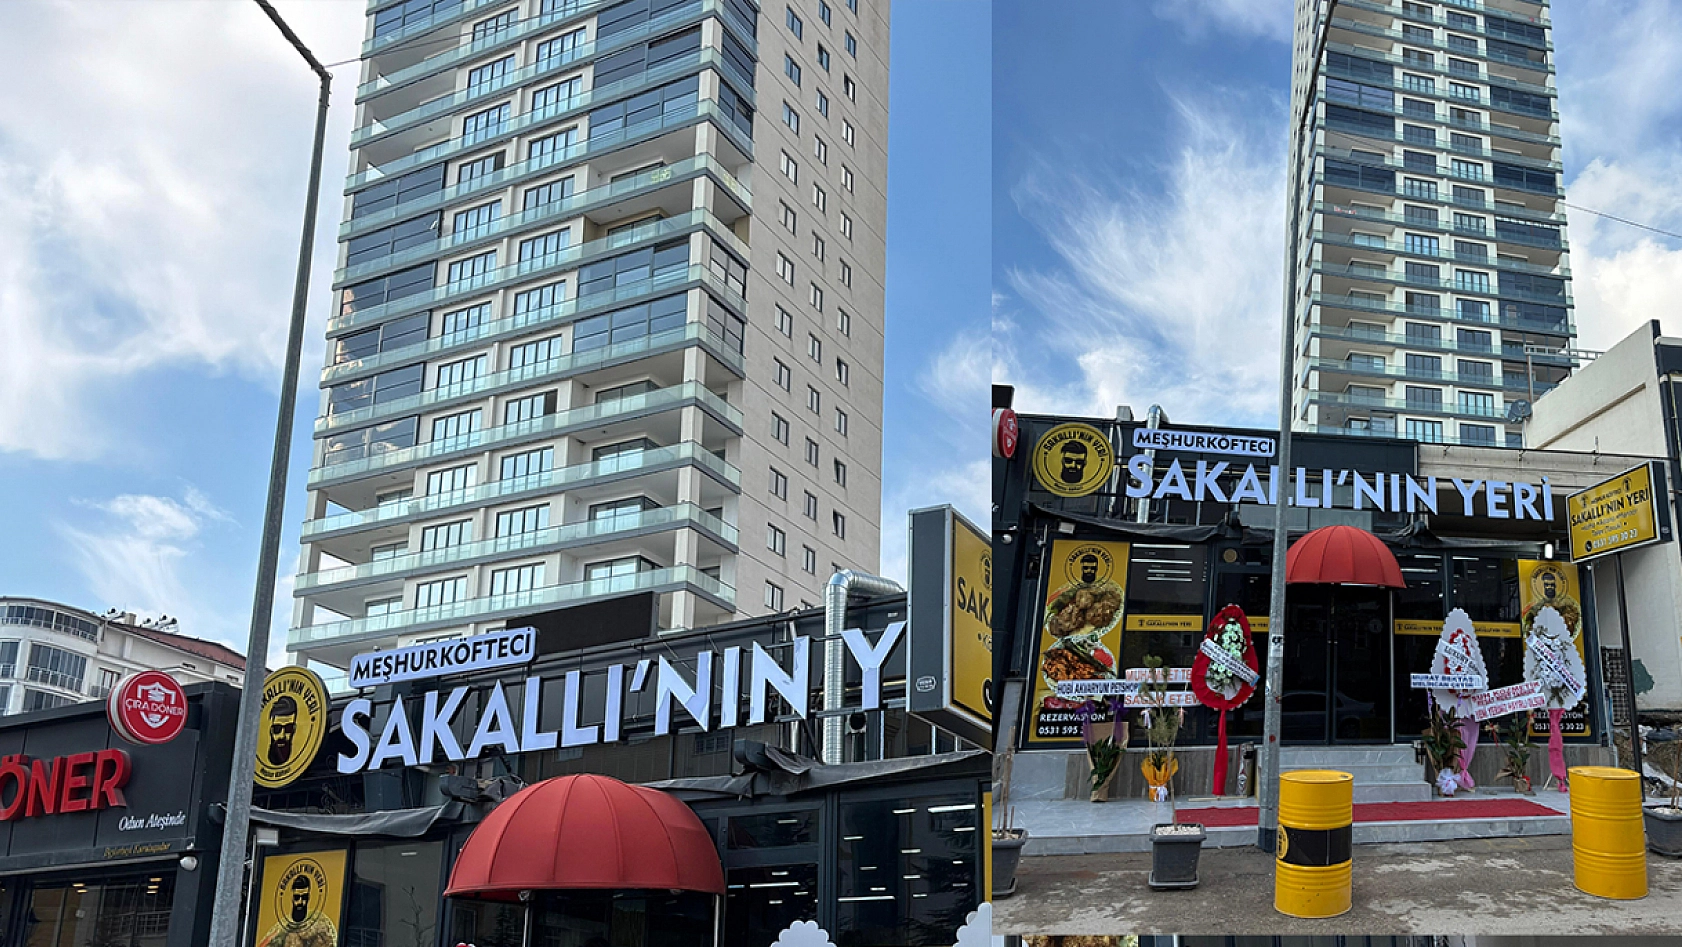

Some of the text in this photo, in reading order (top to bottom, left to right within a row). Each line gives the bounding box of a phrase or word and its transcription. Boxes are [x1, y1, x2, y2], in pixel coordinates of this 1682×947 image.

[1137, 430, 1273, 454] MEŞHURKÖFTECİ
[1126, 453, 1555, 522] SAKALLI'NIN YERİ
[1626, 484, 1650, 508] YERİ
[353, 626, 533, 683] MEŞHURKÖFTECİ
[336, 634, 811, 774] SAKALLI'NIN
[1038, 725, 1059, 735] 0531
[1061, 725, 1078, 735] 595
[0, 748, 132, 821] ÖNER
